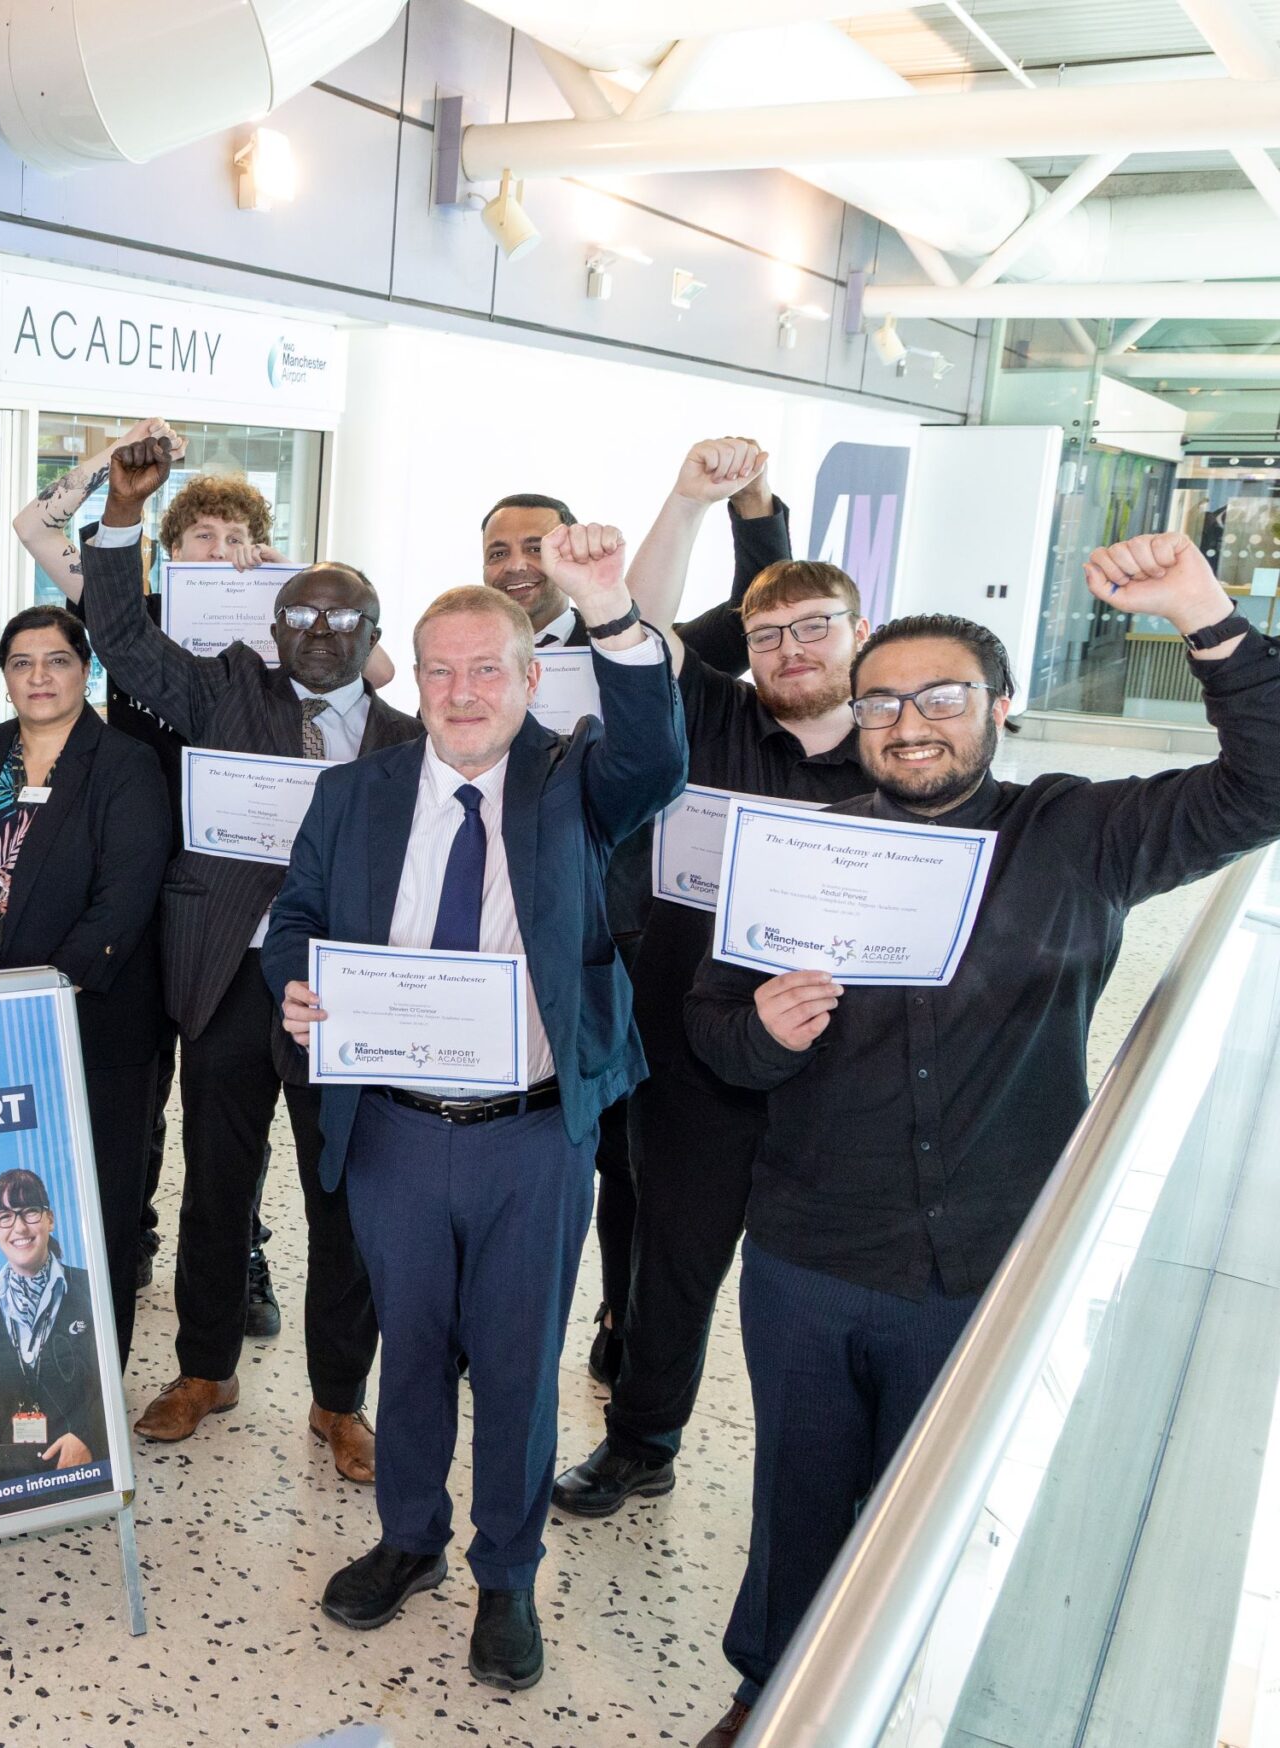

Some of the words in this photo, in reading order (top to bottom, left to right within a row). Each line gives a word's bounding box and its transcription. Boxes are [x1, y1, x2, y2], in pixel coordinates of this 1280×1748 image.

[14, 306, 221, 375] ACADEMY
[283, 342, 295, 351] MAG
[282, 354, 326, 371] Manchester
[281, 369, 306, 383] Airport
[246, 774, 275, 782] Academy
[701, 809, 726, 818] Airport
[217, 832, 257, 841] Manchester
[766, 834, 784, 844] The
[785, 838, 821, 851] Airport
[823, 842, 870, 858] Academy
[872, 850, 882, 858] at
[884, 850, 943, 865] Manchester
[832, 857, 869, 870] Airport
[690, 884, 714, 894] Airport
[820, 888, 842, 898] Abdul
[843, 892, 867, 901] Pervez
[765, 926, 779, 934] MAG
[764, 932, 825, 951] Manchester
[764, 941, 796, 954] Airport
[864, 945, 907, 953] AIRPORT
[862, 952, 910, 961] ACADEMY
[342, 967, 357, 975] The
[358, 969, 388, 979] Airport
[389, 971, 425, 981] Academy
[437, 974, 486, 983] Manchester
[397, 981, 427, 990] Airport
[355, 1047, 406, 1056] Manchester
[355, 1055, 383, 1063] Airport
[438, 1056, 480, 1064] ACADEMY
[26, 1466, 101, 1491] information
